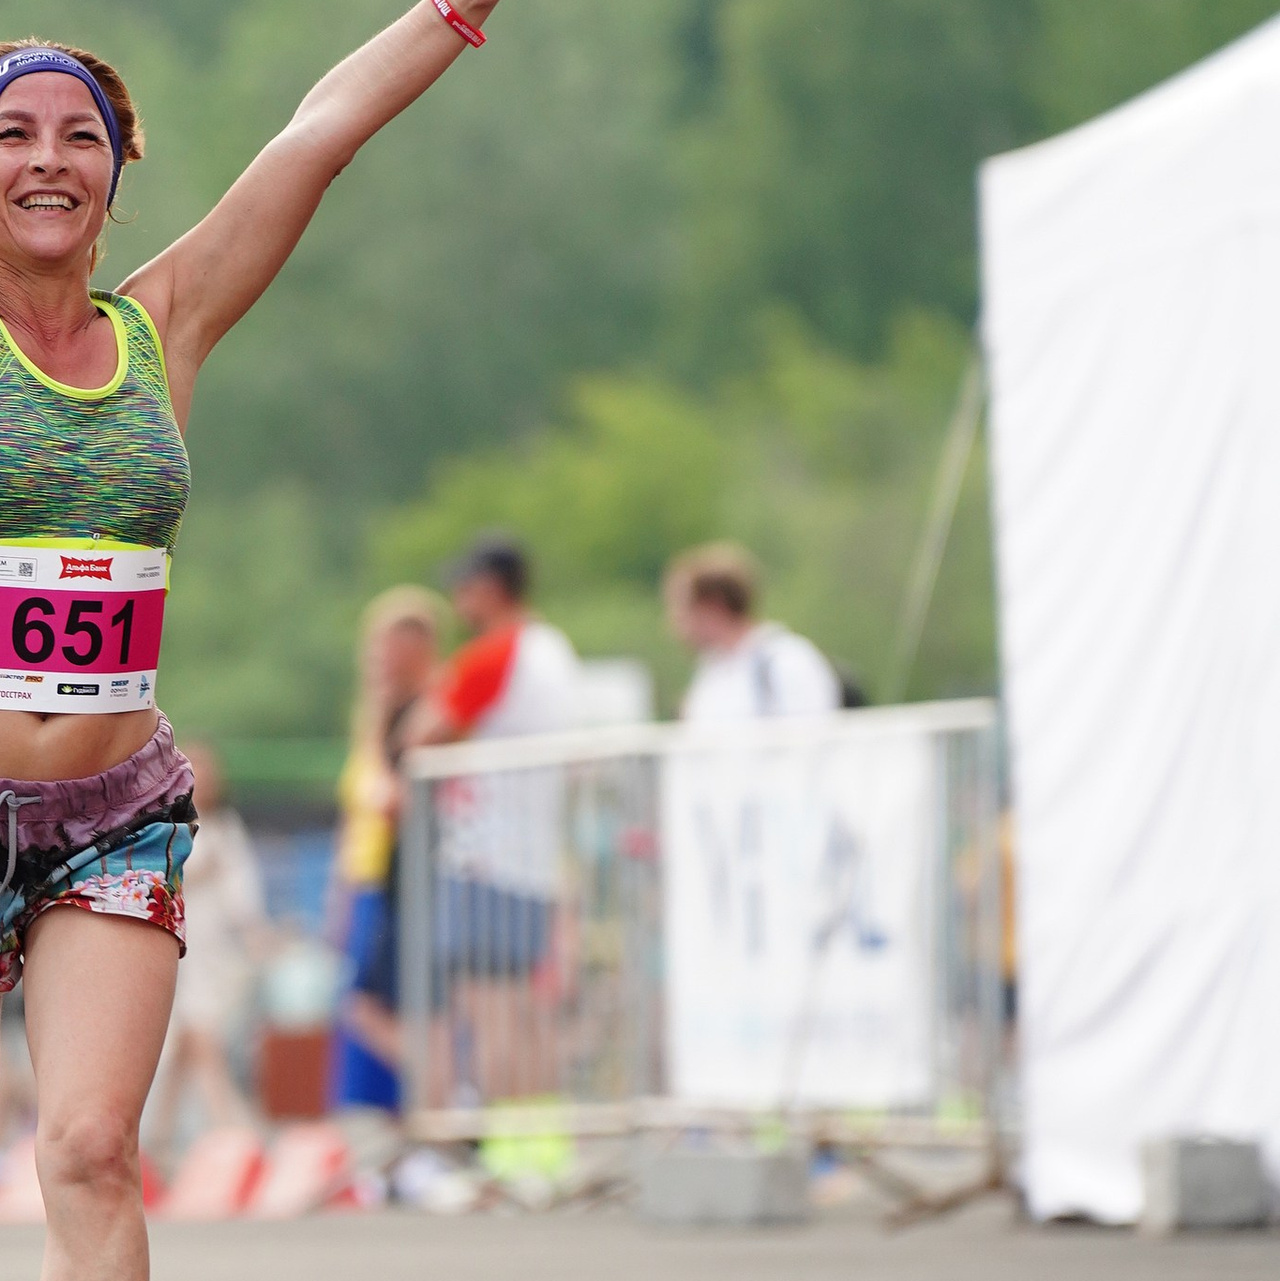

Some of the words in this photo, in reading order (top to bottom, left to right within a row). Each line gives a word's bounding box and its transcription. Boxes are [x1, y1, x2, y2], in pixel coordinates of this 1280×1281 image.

[16, 54, 78, 69] MARATHON
[65, 563, 89, 573] Альфа
[12, 597, 135, 666] 651
